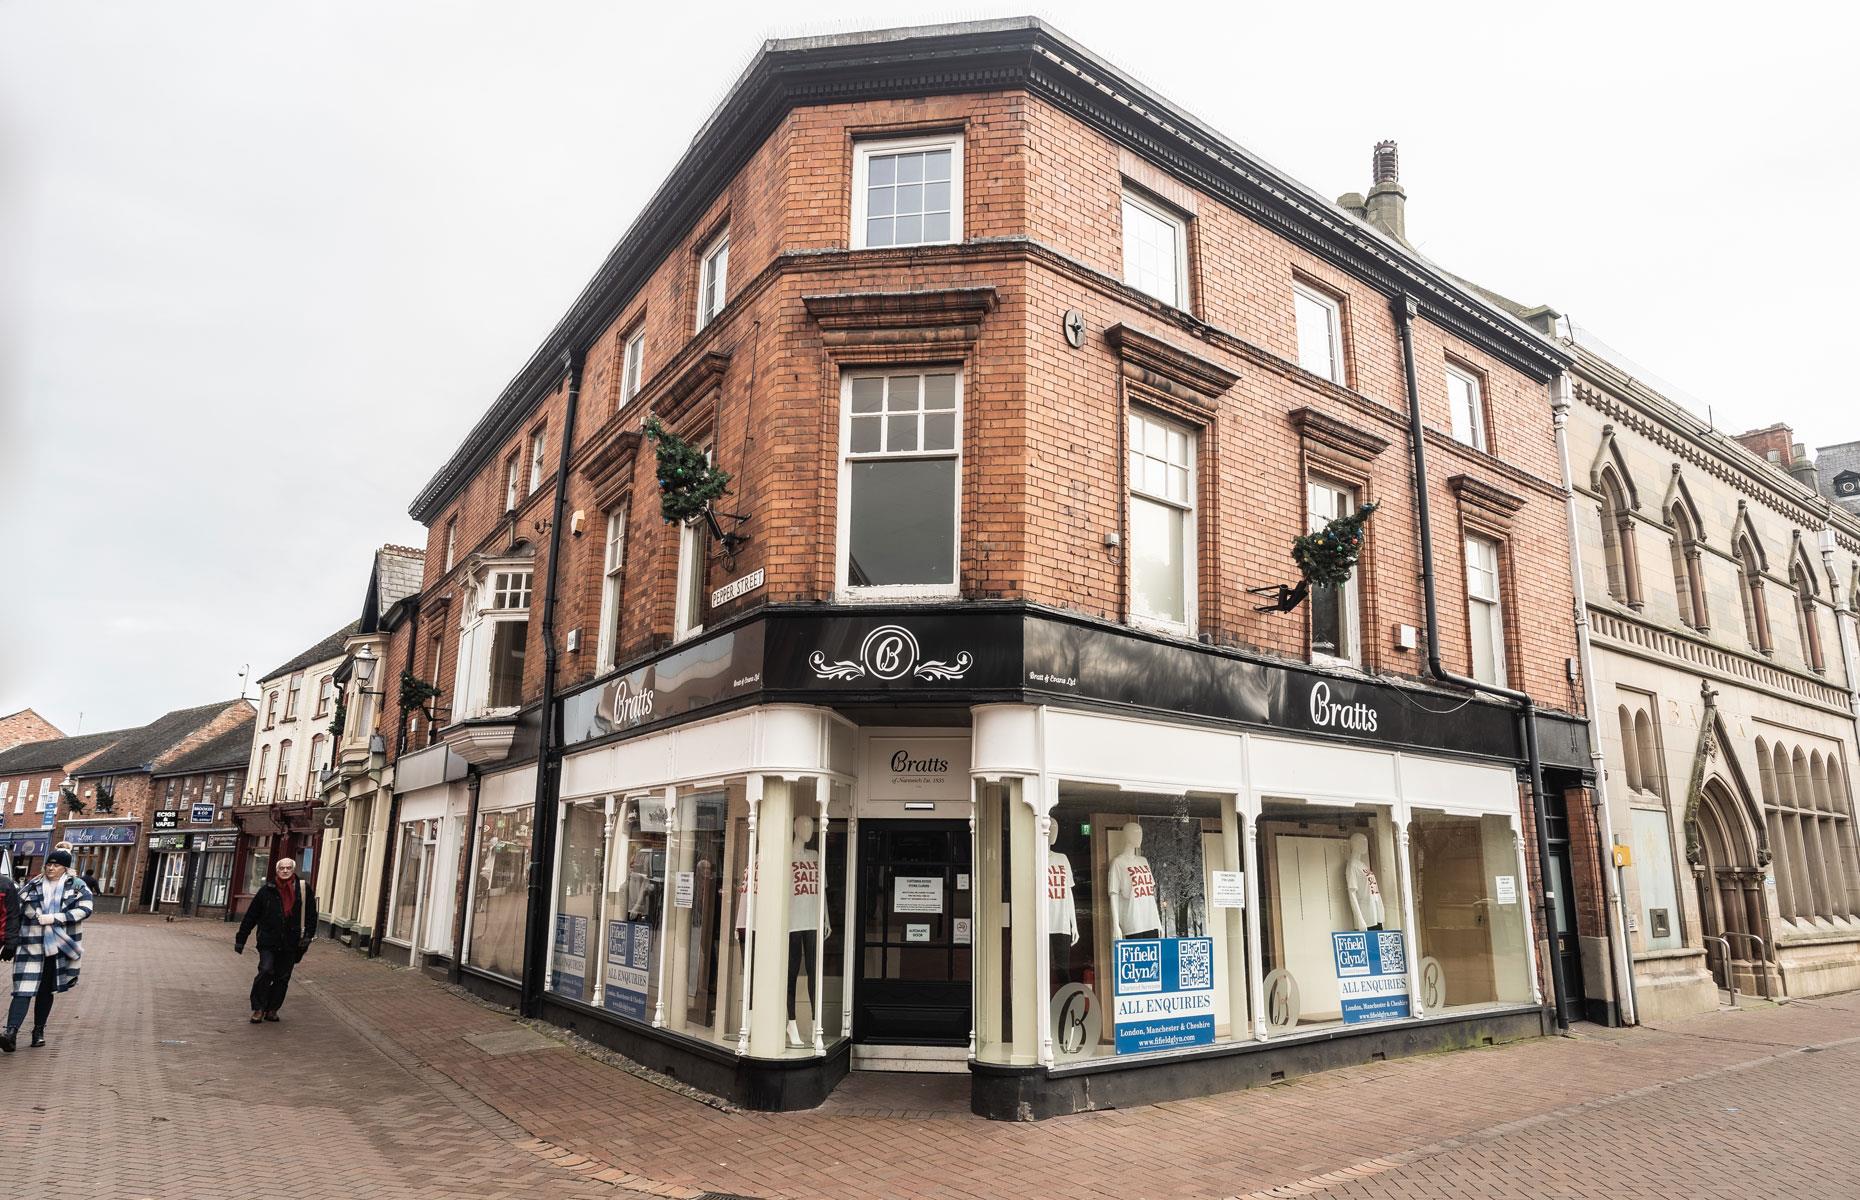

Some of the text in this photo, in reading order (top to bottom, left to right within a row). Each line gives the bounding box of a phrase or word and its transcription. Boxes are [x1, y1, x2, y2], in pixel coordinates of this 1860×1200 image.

[712, 570, 763, 607] PEPPER STREET
[613, 681, 654, 724] Bratts
[1310, 681, 1378, 732] Bratts
[890, 749, 949, 773] Bratts
[324, 812, 334, 826] 6
[1337, 936, 1365, 951] Fifield
[1121, 945, 1157, 963] Fifield
[1340, 950, 1360, 967] Glyn
[618, 969, 648, 987] ENQUIRIES
[1121, 961, 1151, 982] Glyn
[1342, 978, 1407, 994] ALL ENQUIRIES
[1119, 994, 1211, 1015] ALL ENQUIRIES
[1120, 1026, 1146, 1037] London,
[1146, 1023, 1180, 1034] Manchester
[1186, 1020, 1211, 1030] Cheshire
[1138, 1035, 1196, 1048] www.fifieldglyn.com
